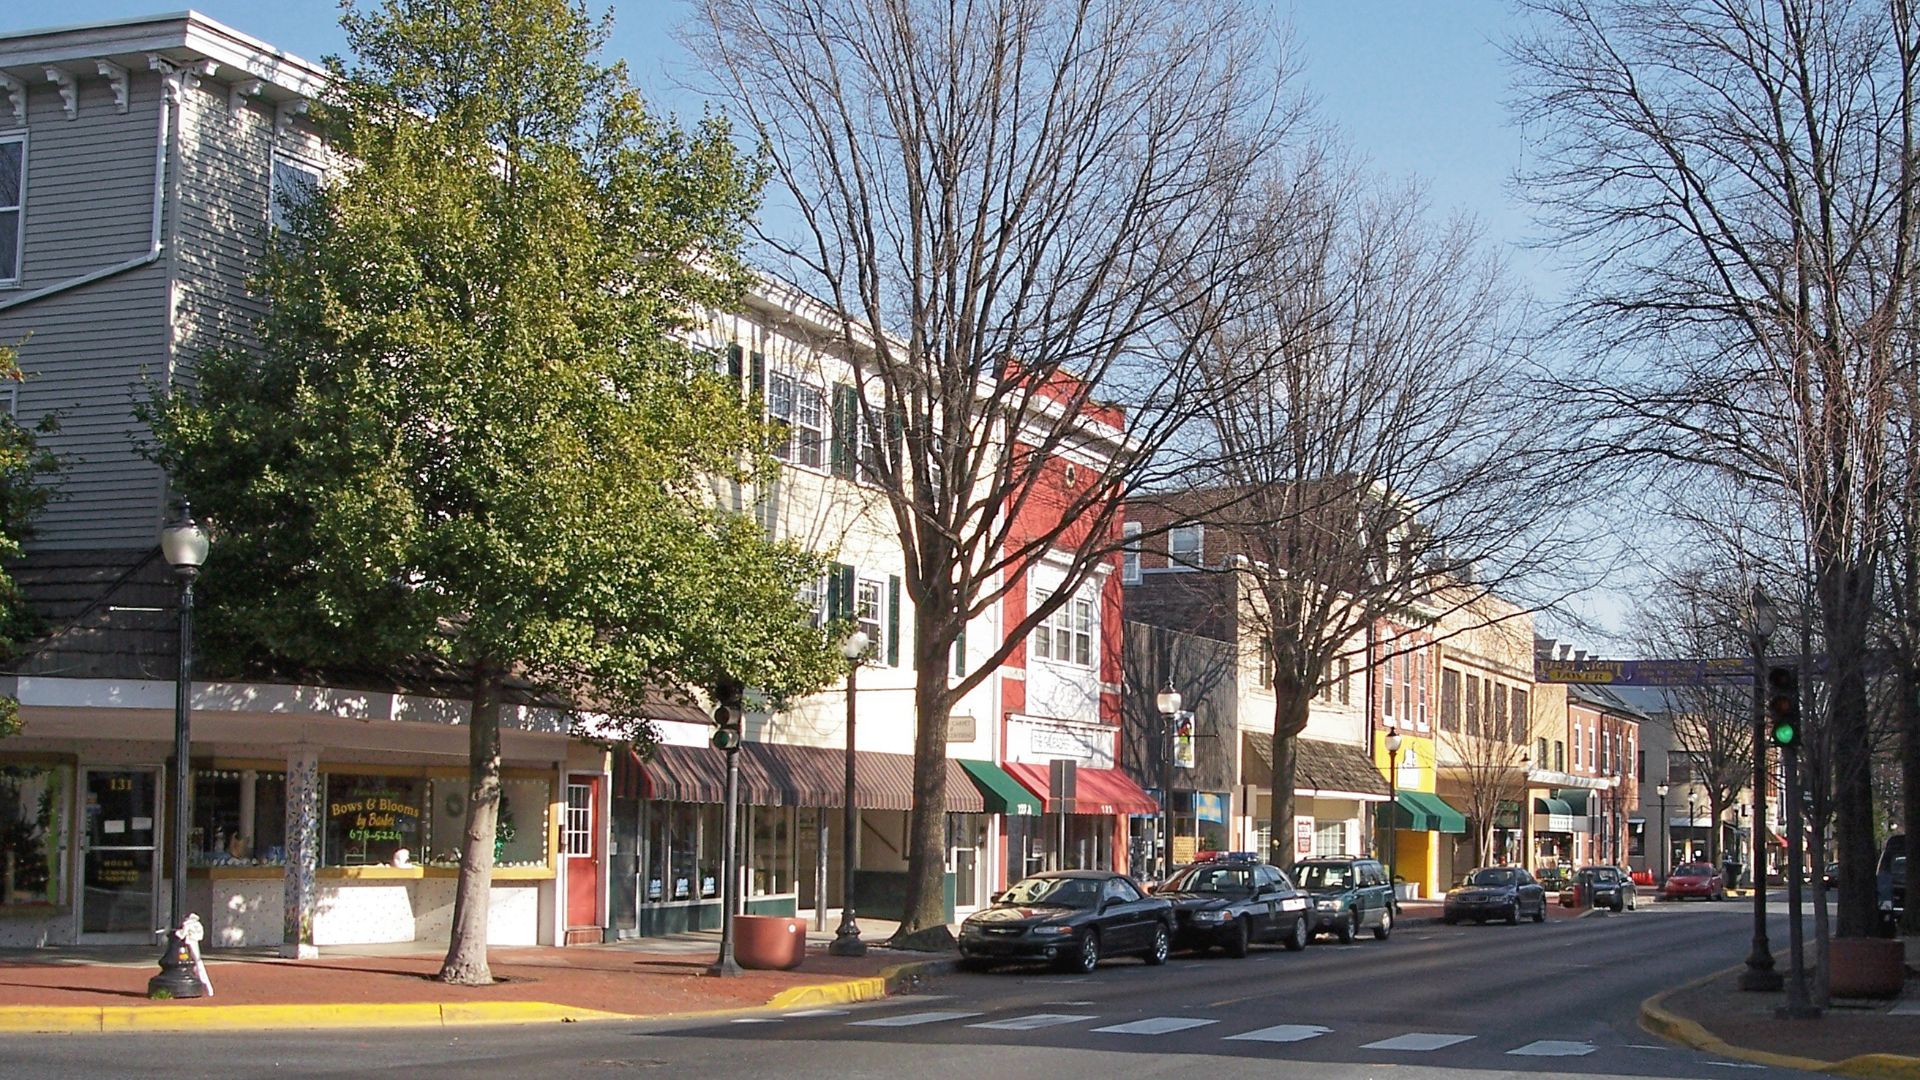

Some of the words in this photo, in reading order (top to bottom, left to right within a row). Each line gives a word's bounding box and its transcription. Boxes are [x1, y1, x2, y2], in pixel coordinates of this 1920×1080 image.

[111, 779, 132, 790] 131
[331, 801, 363, 816] Bows
[366, 798, 377, 811] &
[379, 798, 420, 818] Blooms
[356, 813, 367, 829] by
[349, 828, 402, 841] 678-5226
